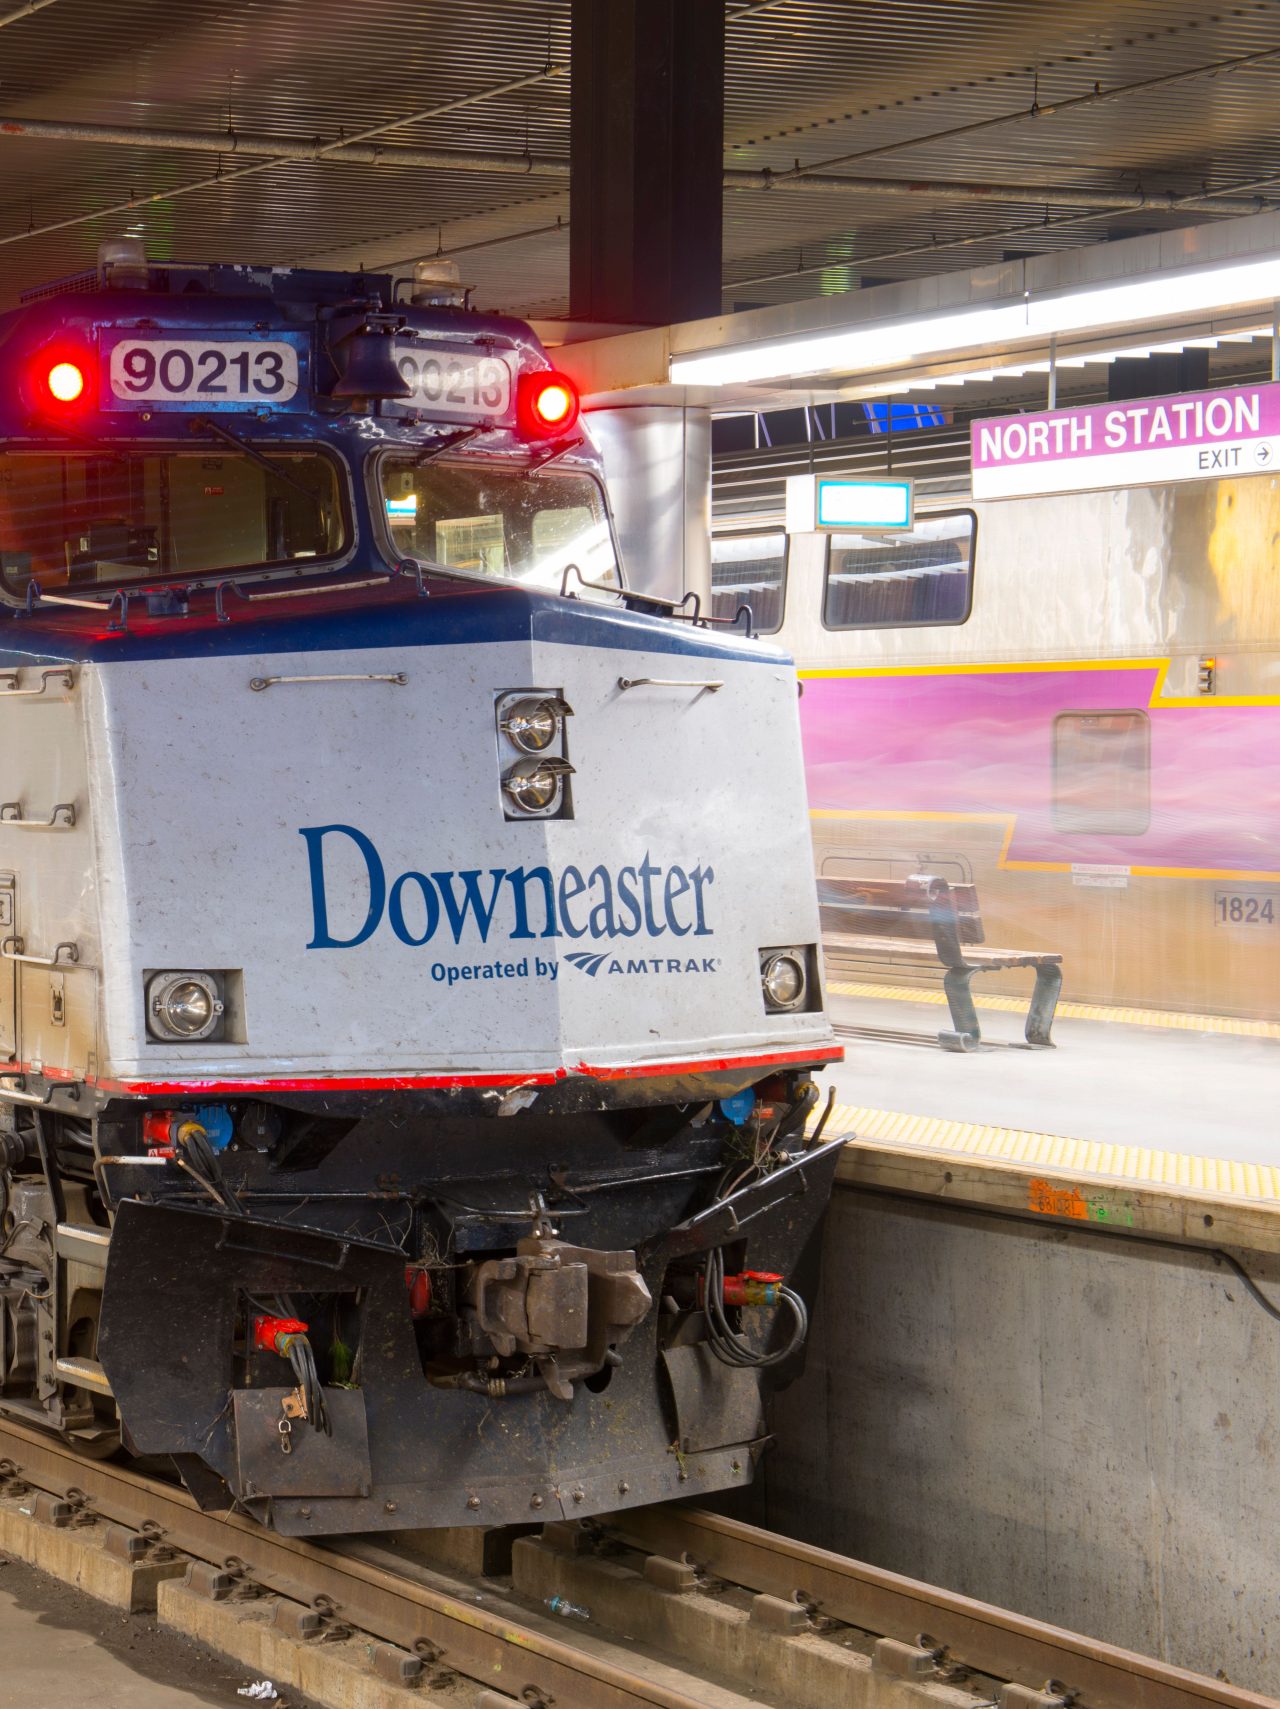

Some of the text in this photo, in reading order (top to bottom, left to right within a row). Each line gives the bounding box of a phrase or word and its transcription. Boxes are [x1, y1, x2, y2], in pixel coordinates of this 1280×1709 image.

[123, 348, 285, 394] 90213
[980, 394, 1260, 462] NORTH STATION
[1198, 447, 1242, 470] EXIT
[298, 823, 714, 950] Downeaster
[1218, 896, 1275, 924] 1824
[431, 956, 717, 986] Operated by AMTRAK
